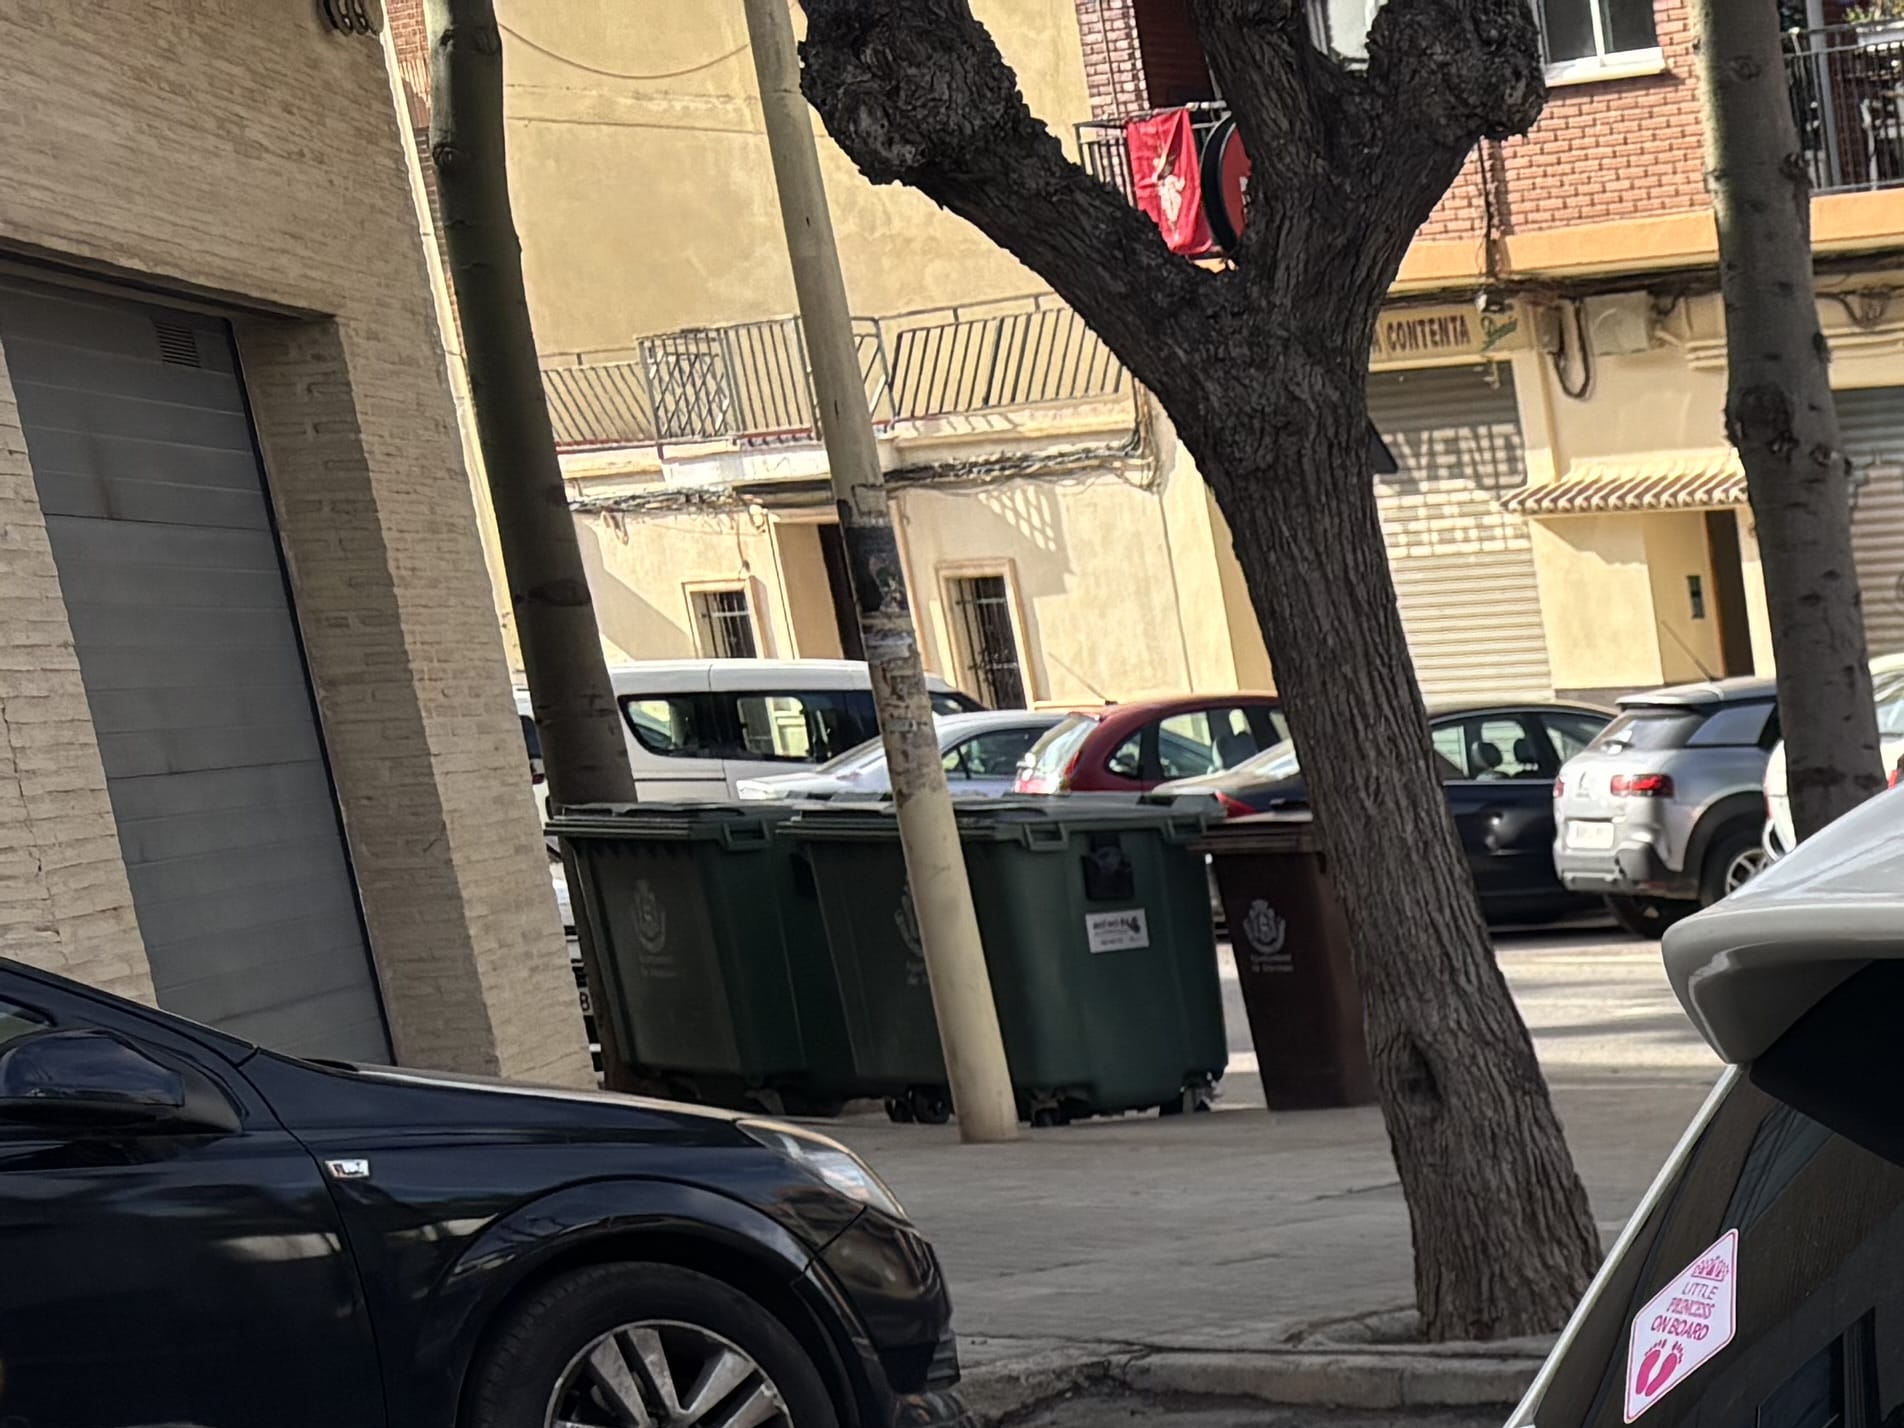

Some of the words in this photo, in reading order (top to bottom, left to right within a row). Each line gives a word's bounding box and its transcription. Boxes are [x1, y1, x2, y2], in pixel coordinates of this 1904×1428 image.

[1386, 314, 1471, 352] CONTENTA
[1682, 1281, 1719, 1300] LITTLE
[1650, 1314, 1671, 1333] ON
[1667, 1317, 1710, 1341] BOARD
